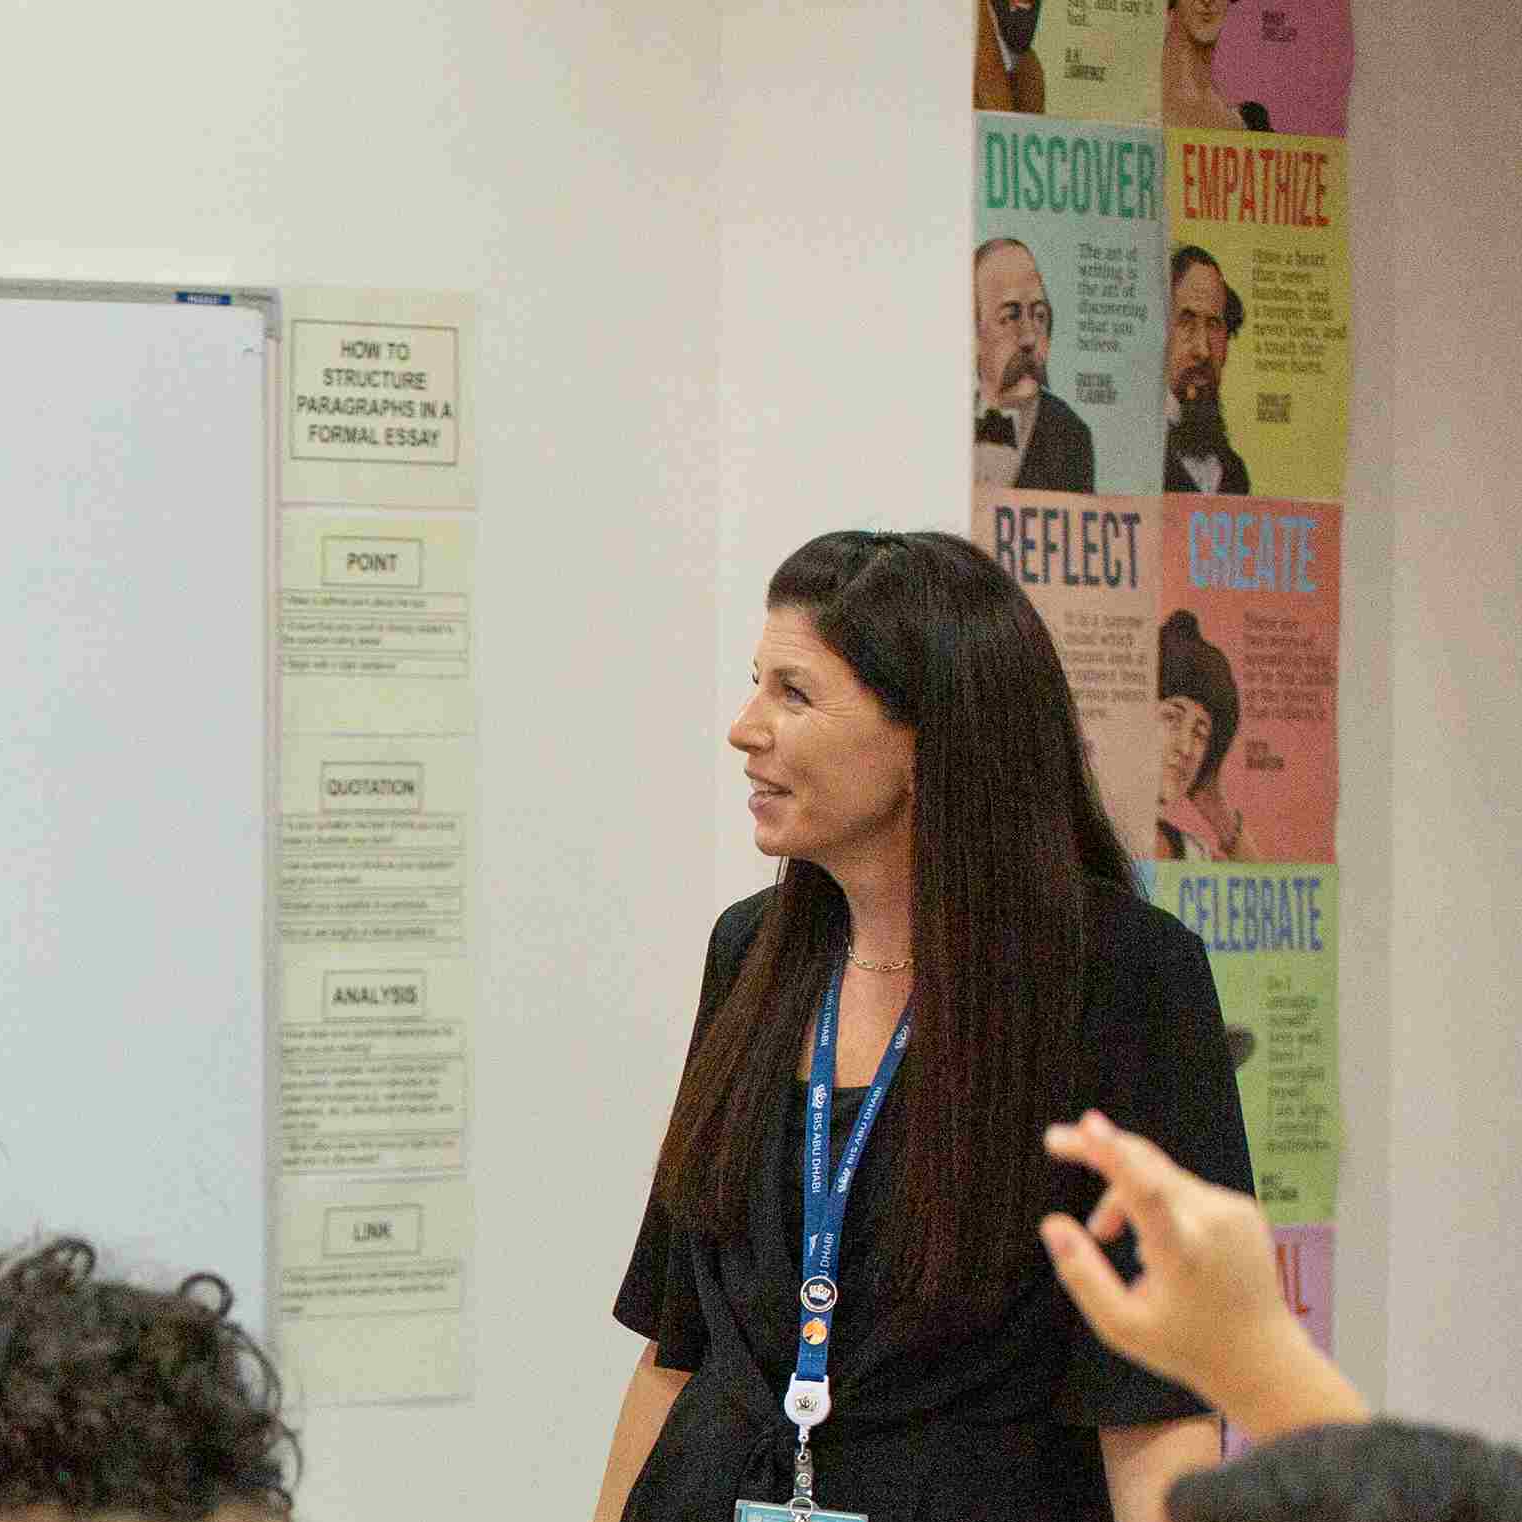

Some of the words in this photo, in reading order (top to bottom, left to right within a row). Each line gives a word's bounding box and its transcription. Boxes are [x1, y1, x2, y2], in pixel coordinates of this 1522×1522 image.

[984, 131, 1155, 219] DISCOVER
[1182, 144, 1330, 226] EMPATHIZE
[341, 340, 380, 360] HOW
[387, 342, 411, 361] TO
[322, 368, 428, 390] STRUCTURE
[296, 395, 415, 419] PARAGRAPHS
[420, 401, 435, 418] IN
[440, 402, 453, 419] A
[308, 424, 378, 446] FORMAL
[384, 427, 442, 448] ESSAY
[995, 506, 1141, 588] REFLECT
[1189, 511, 1316, 592] CREATE
[346, 553, 398, 573] POINT
[327, 779, 415, 797] QUOTATION
[1178, 877, 1323, 952] CELEBRATE
[331, 984, 418, 1006] ANALYSIS
[813, 1112, 823, 1131] BIS
[812, 1132, 822, 1156] ABU
[811, 1158, 822, 1193] DHABI
[354, 1222, 391, 1241] LINK
